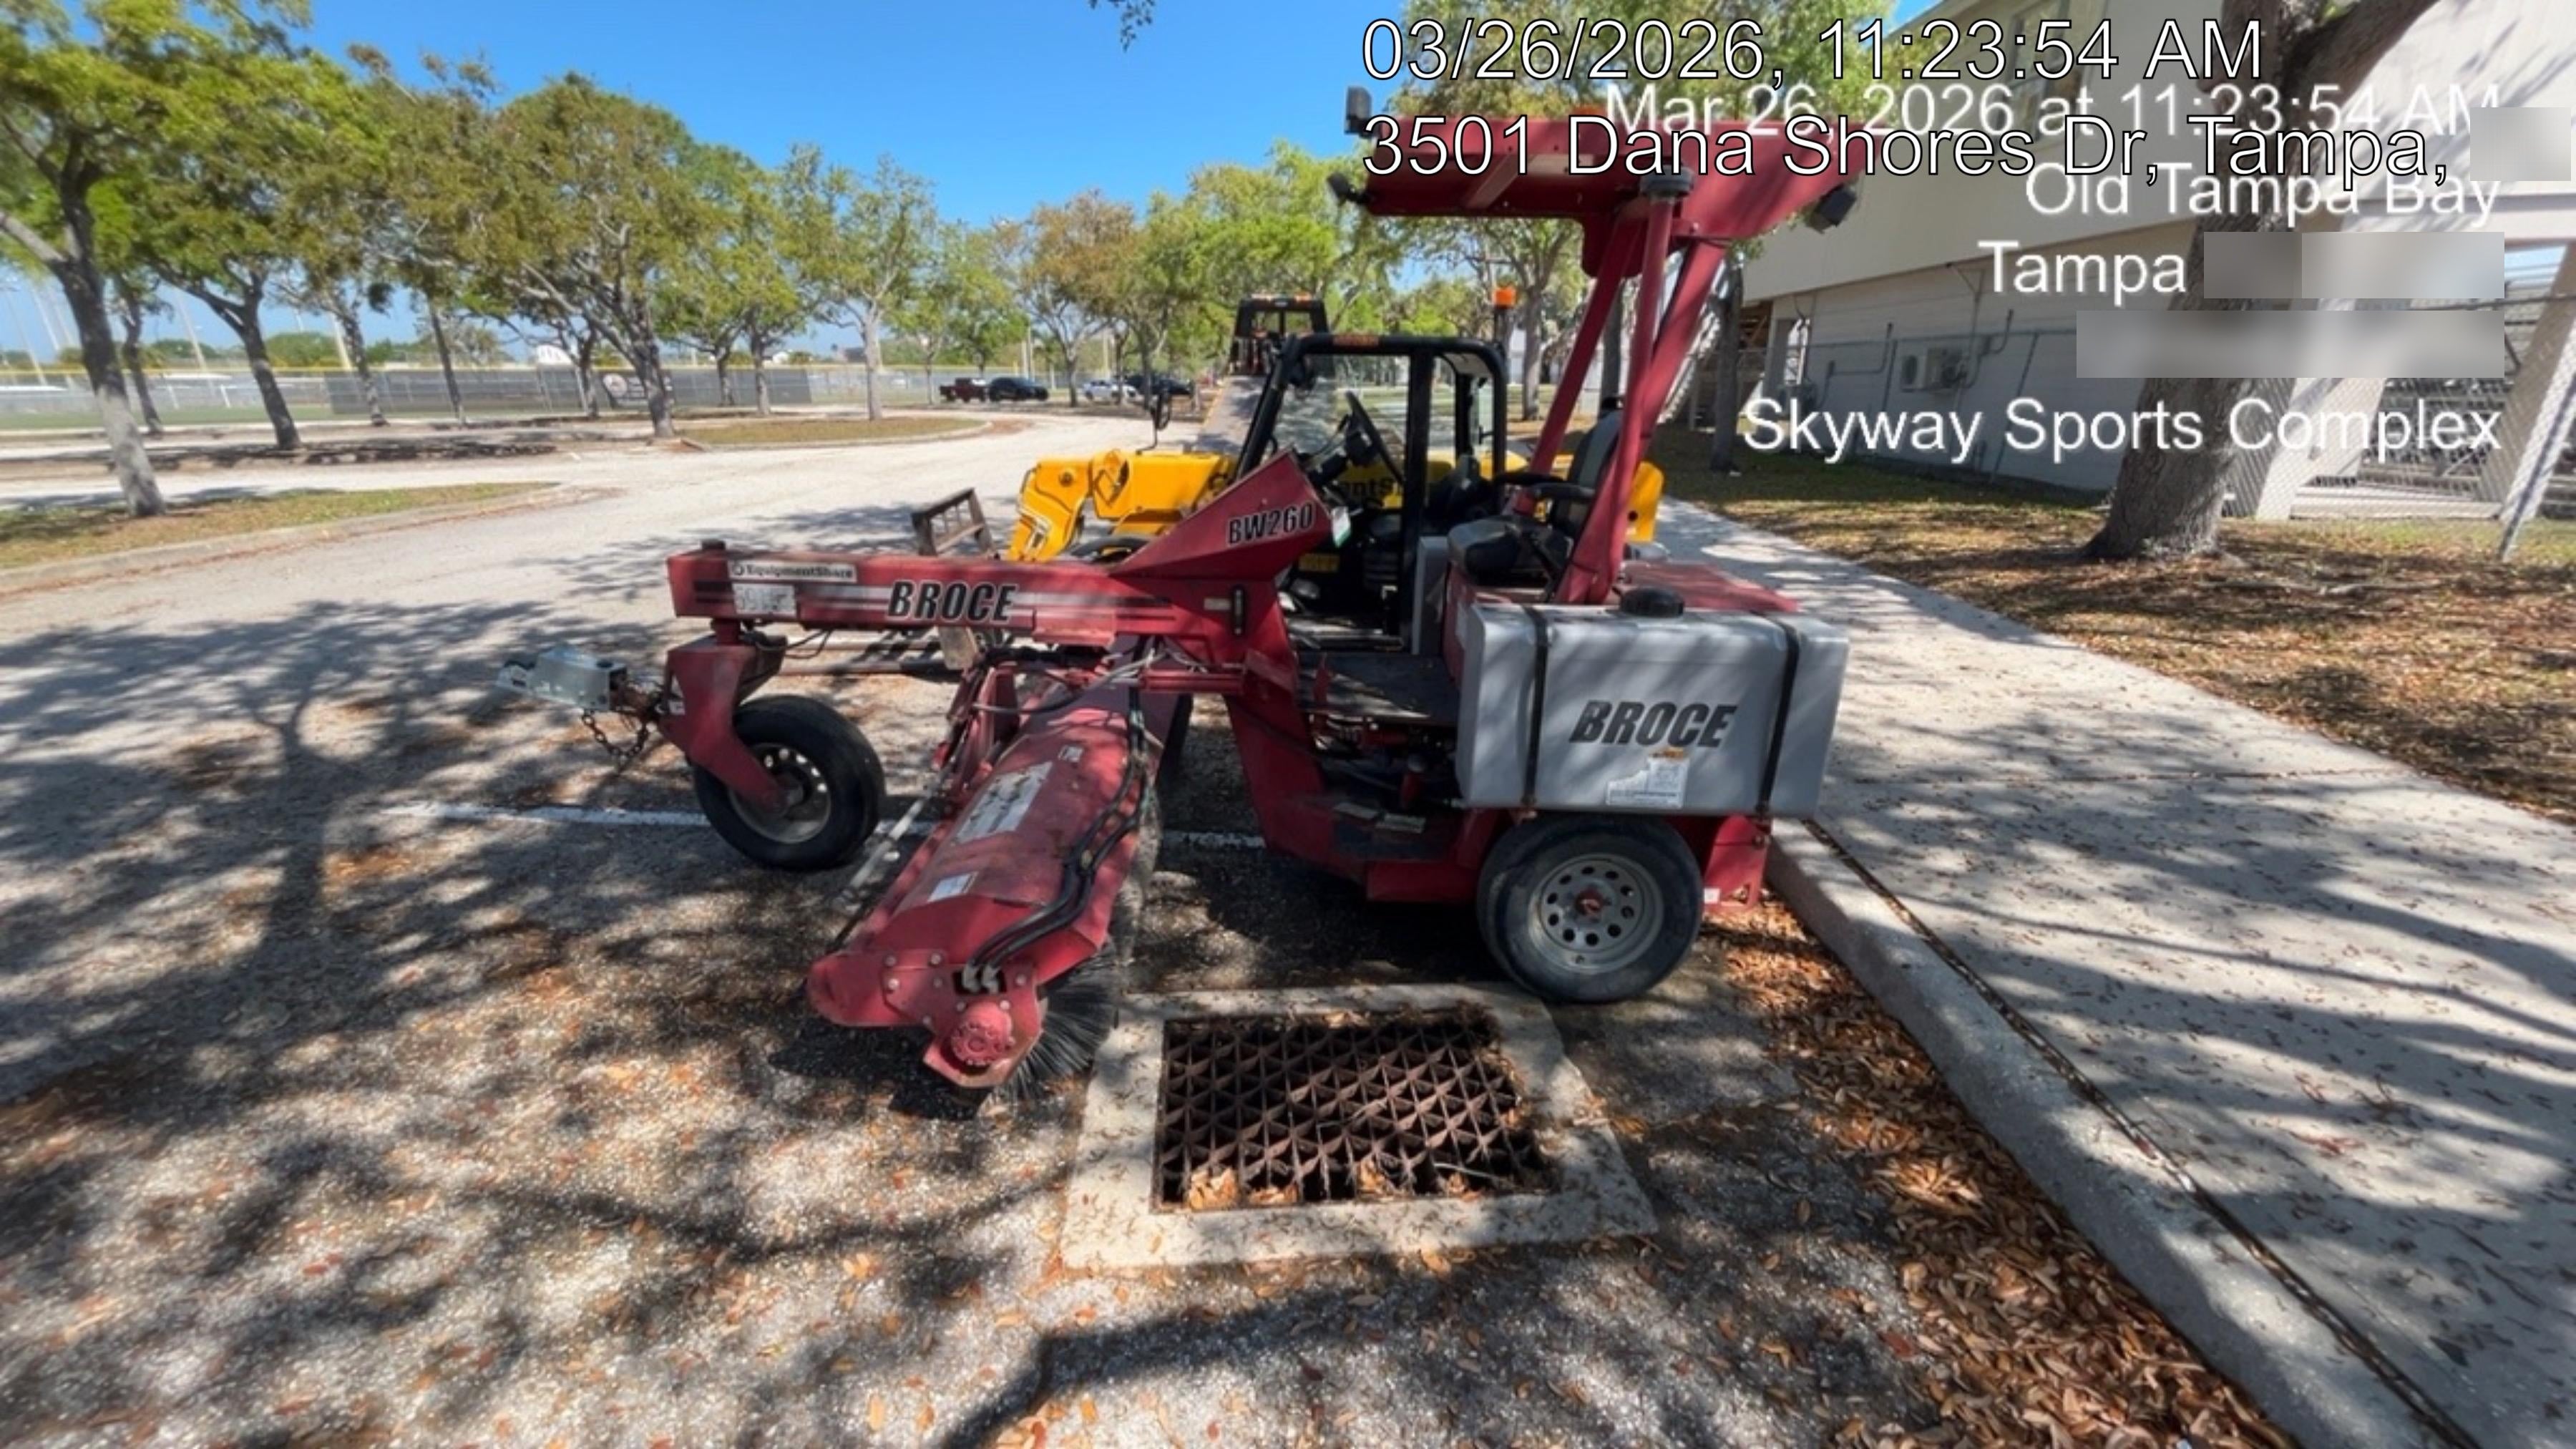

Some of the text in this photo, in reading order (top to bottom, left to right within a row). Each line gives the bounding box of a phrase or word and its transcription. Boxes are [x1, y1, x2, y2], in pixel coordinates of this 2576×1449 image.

[1227, 503, 1315, 547] BW260
[885, 580, 1016, 624] BROCE
[1569, 700, 1739, 748] BROCE
